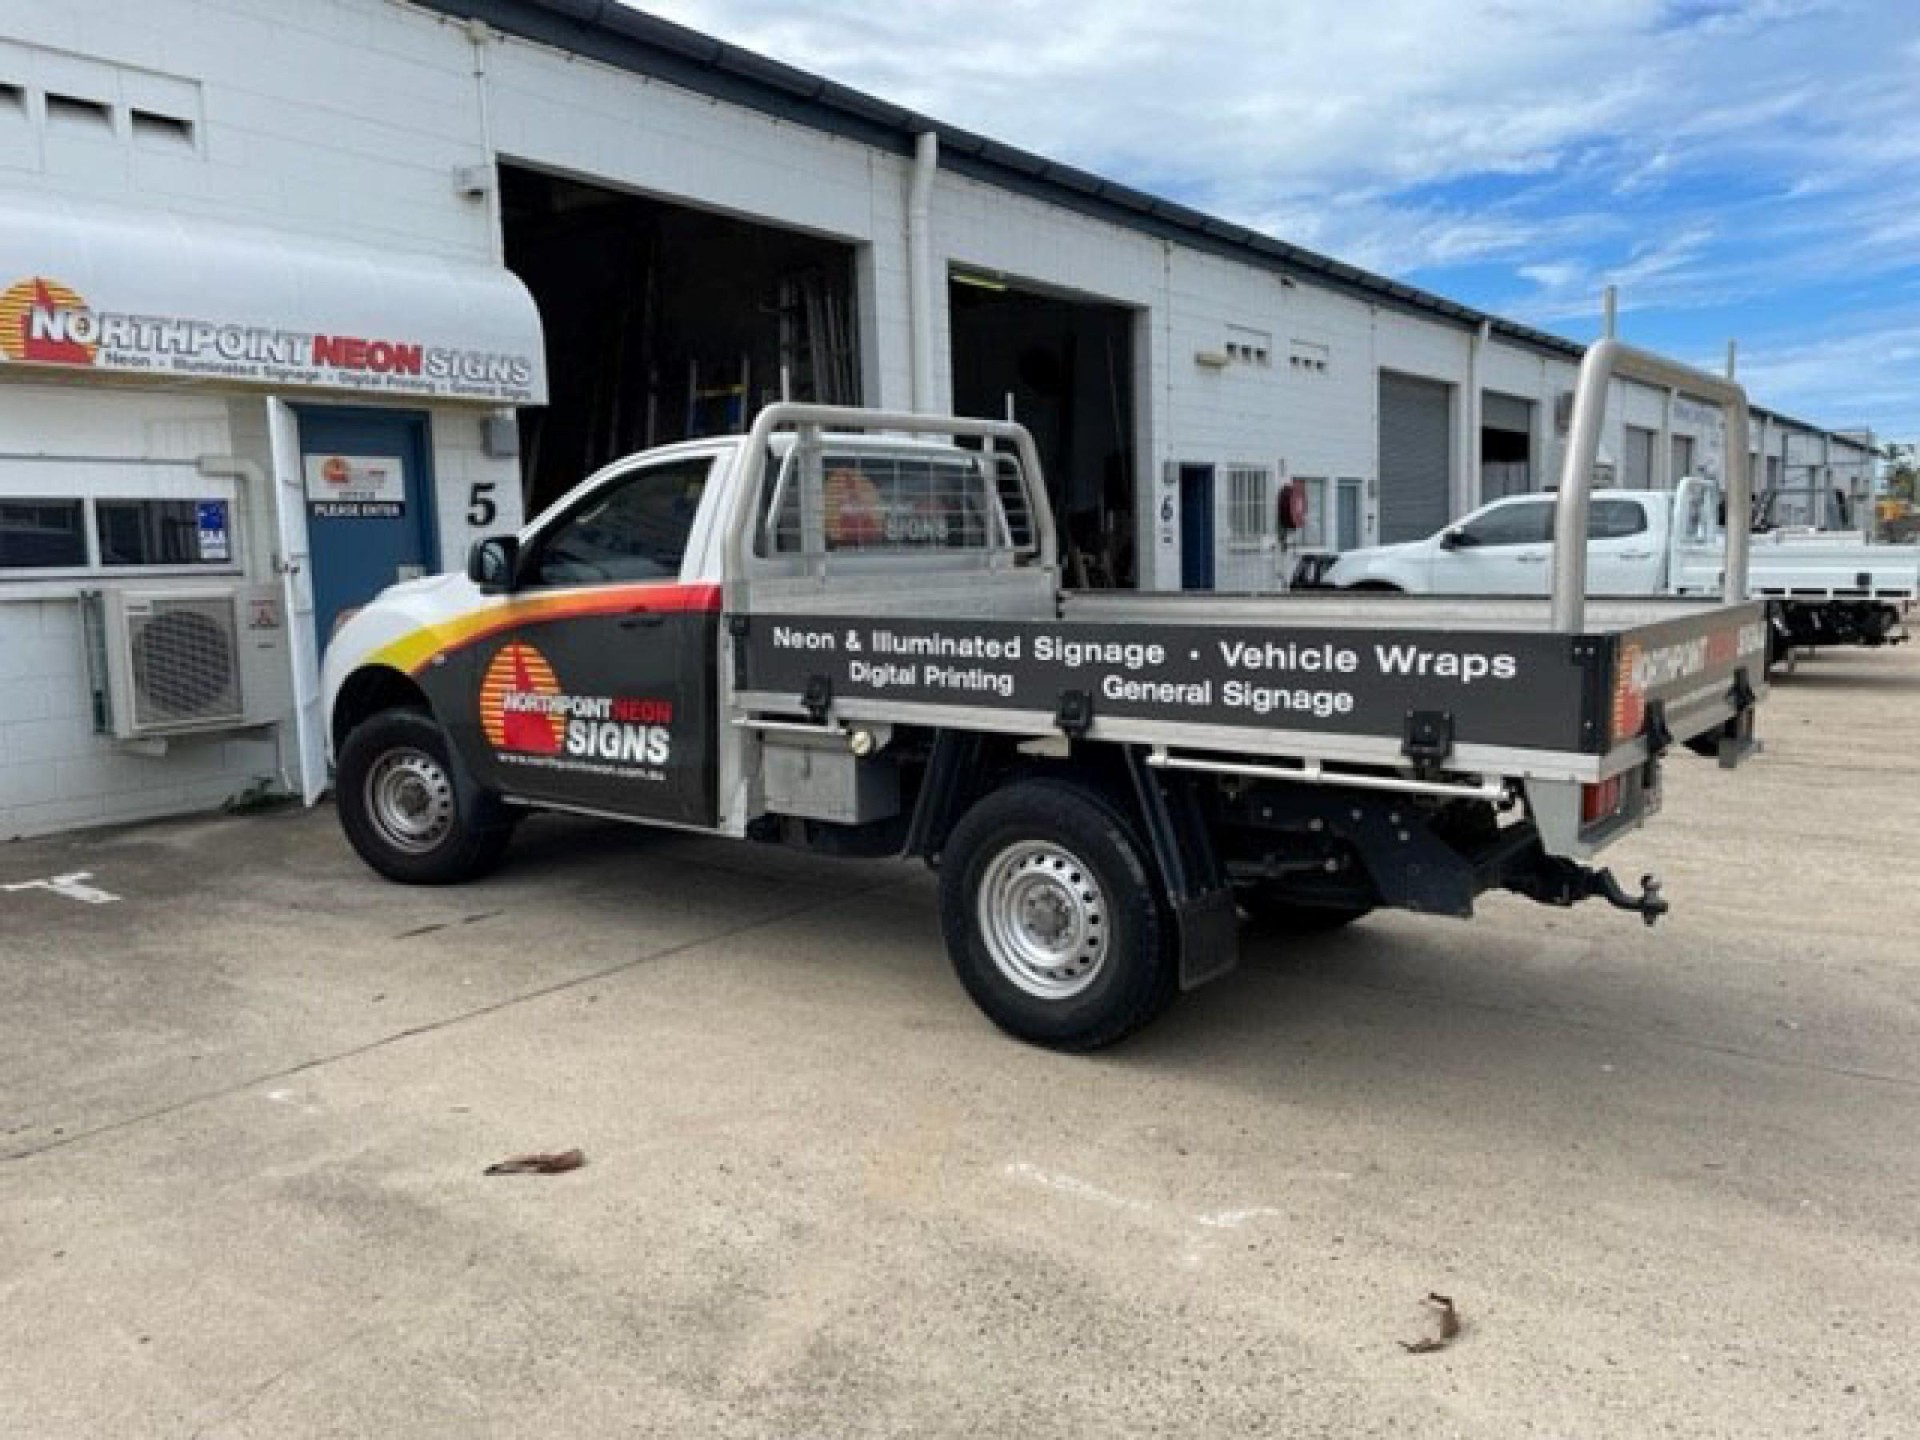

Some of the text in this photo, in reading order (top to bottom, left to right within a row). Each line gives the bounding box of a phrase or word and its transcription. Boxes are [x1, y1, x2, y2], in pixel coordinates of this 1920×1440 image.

[30, 305, 532, 385] NORTHPOINT NEON SIGNS
[466, 482, 496, 527] 5
[773, 626, 836, 650] Neon
[845, 629, 862, 651] &
[872, 629, 1022, 660] Illuminated
[1033, 634, 1166, 670] Signage
[1218, 640, 1359, 673] Vehicle
[1373, 644, 1517, 684] Wraps
[504, 691, 672, 724] NORTHPOINT NEON
[848, 660, 1354, 717] Digital Printing General Signage
[566, 718, 671, 767] SIGNS
